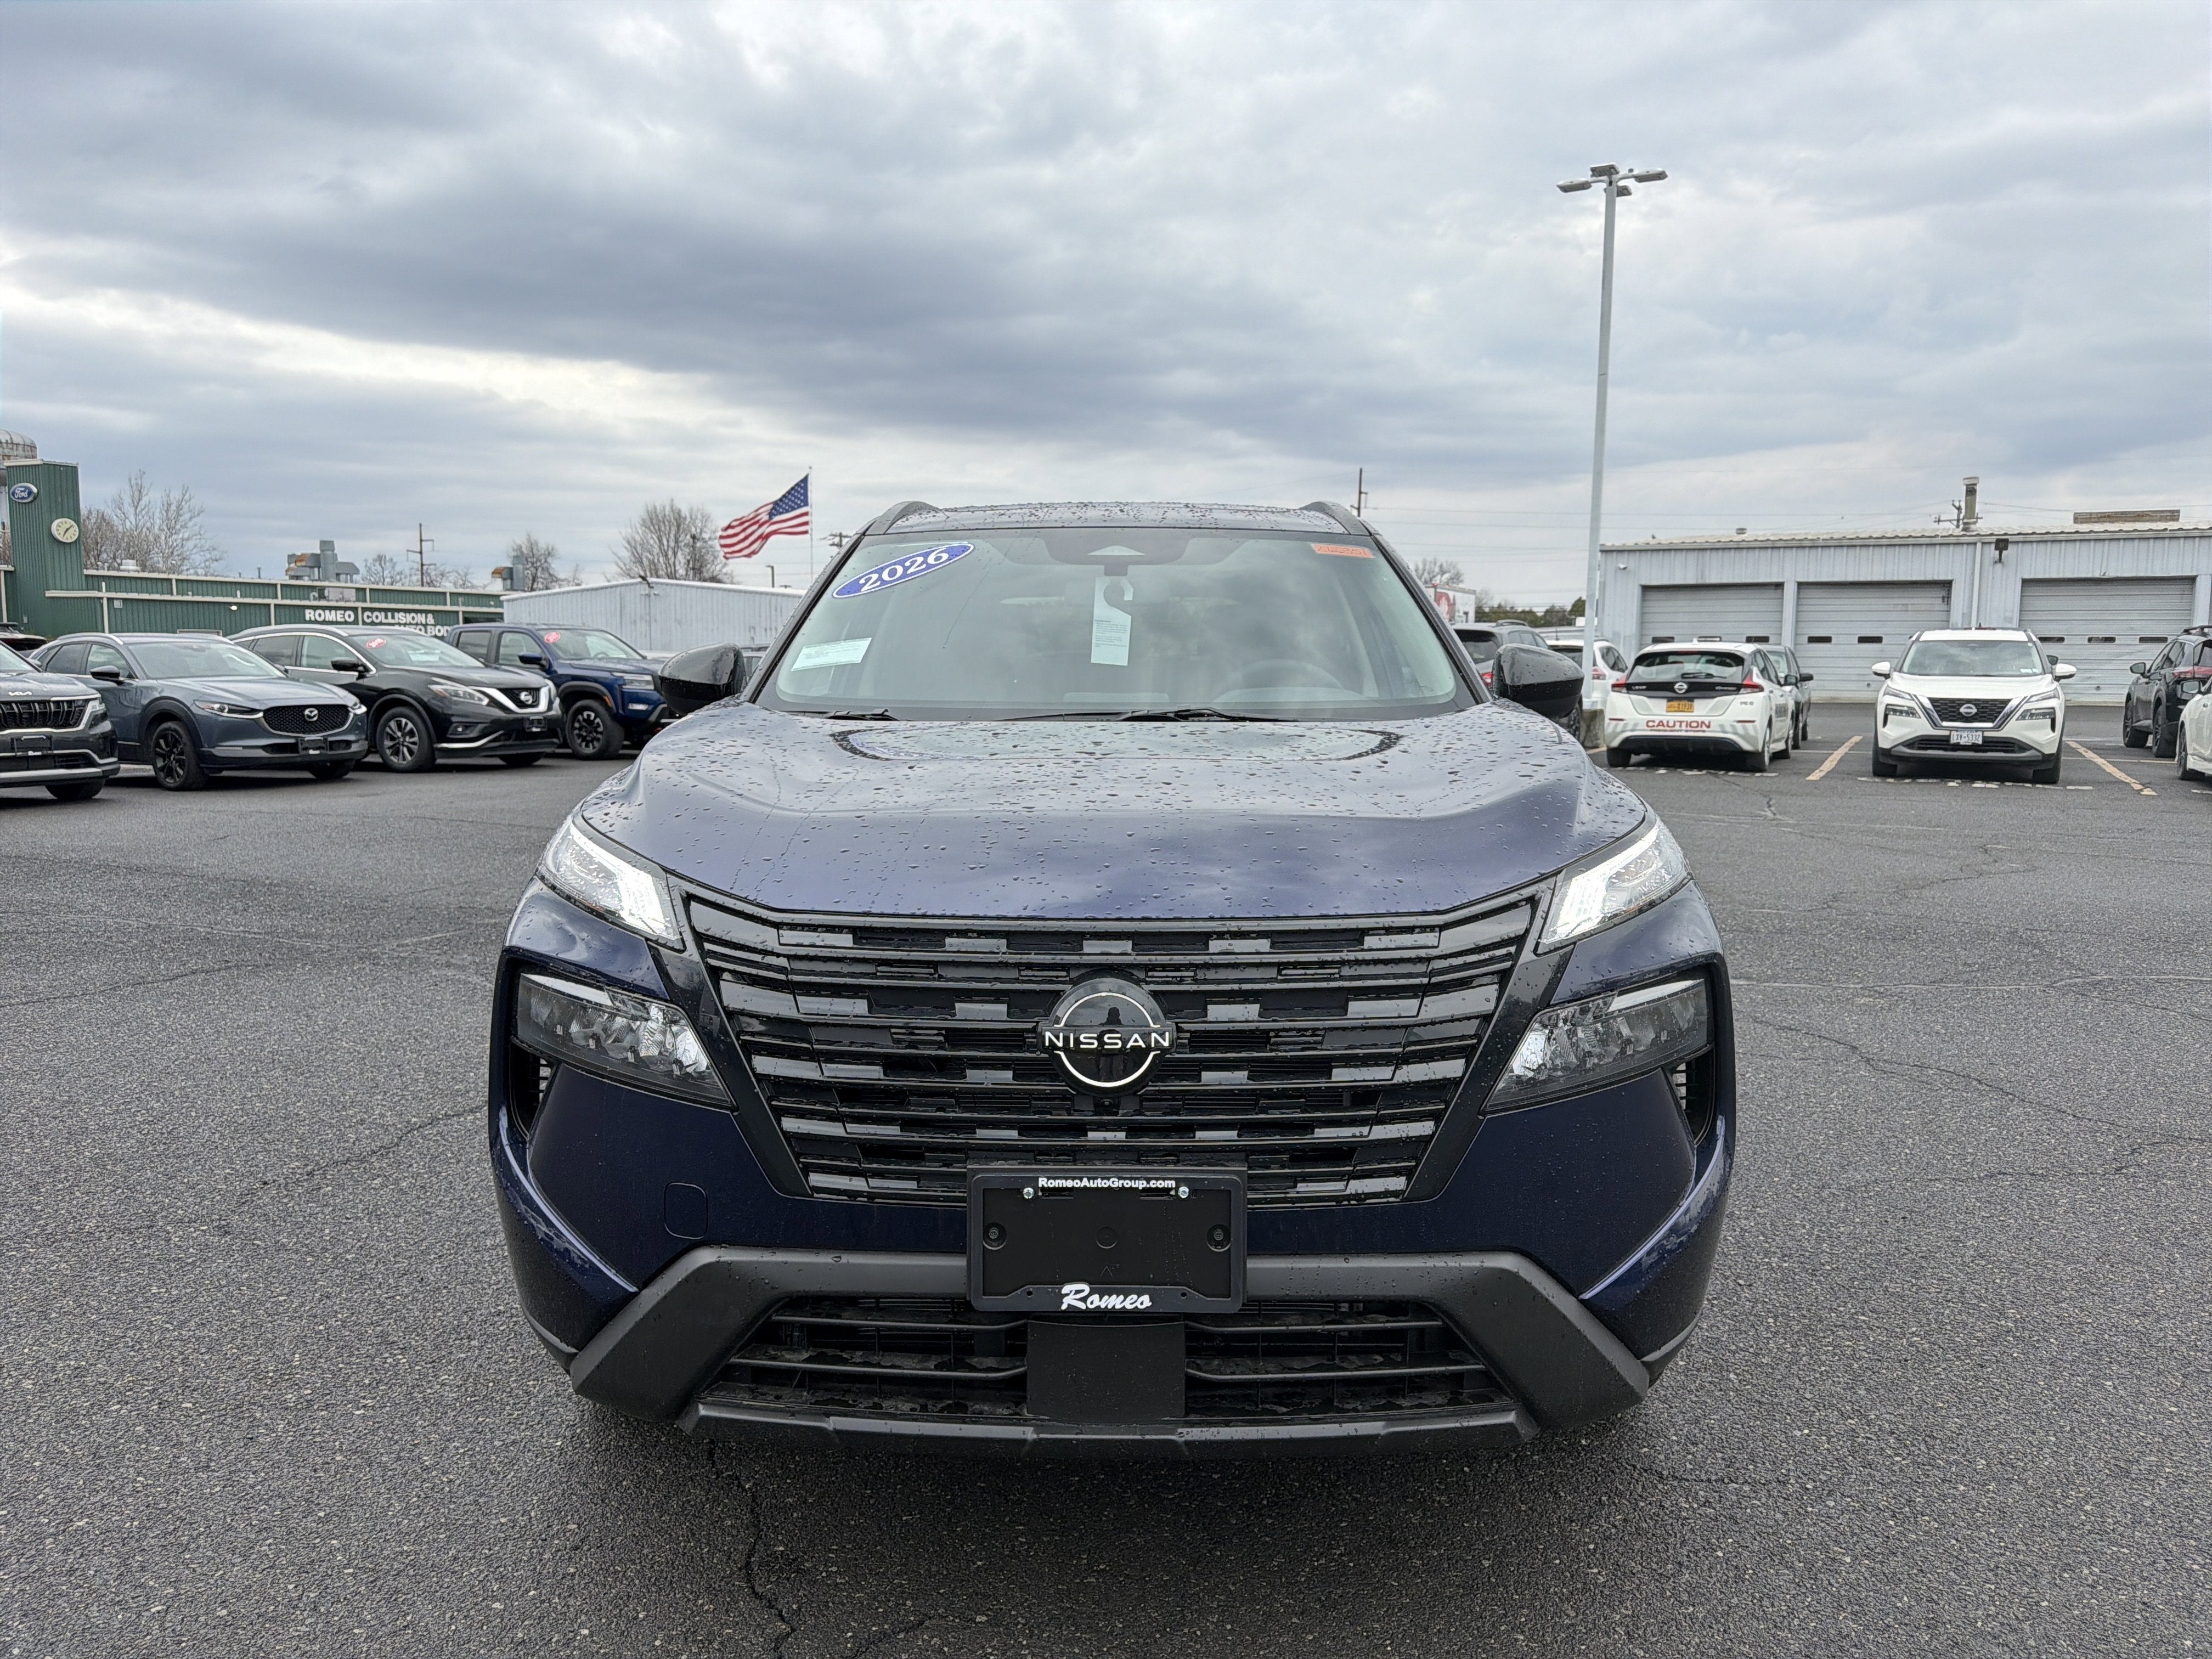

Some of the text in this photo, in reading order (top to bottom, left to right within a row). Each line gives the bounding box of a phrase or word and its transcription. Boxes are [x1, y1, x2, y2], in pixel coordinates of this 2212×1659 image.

[14, 487, 29, 498] Ford
[859, 547, 949, 592] 2026
[305, 609, 355, 622] ROMEO
[363, 611, 426, 624] COLLISION
[427, 625, 452, 637] BOD
[1646, 720, 1711, 729] CAUTION
[1045, 1031, 1169, 1048] NISSAN
[1039, 1177, 1176, 1189] RomeoAutoGroup.com
[1060, 1284, 1152, 1310] Romeo
